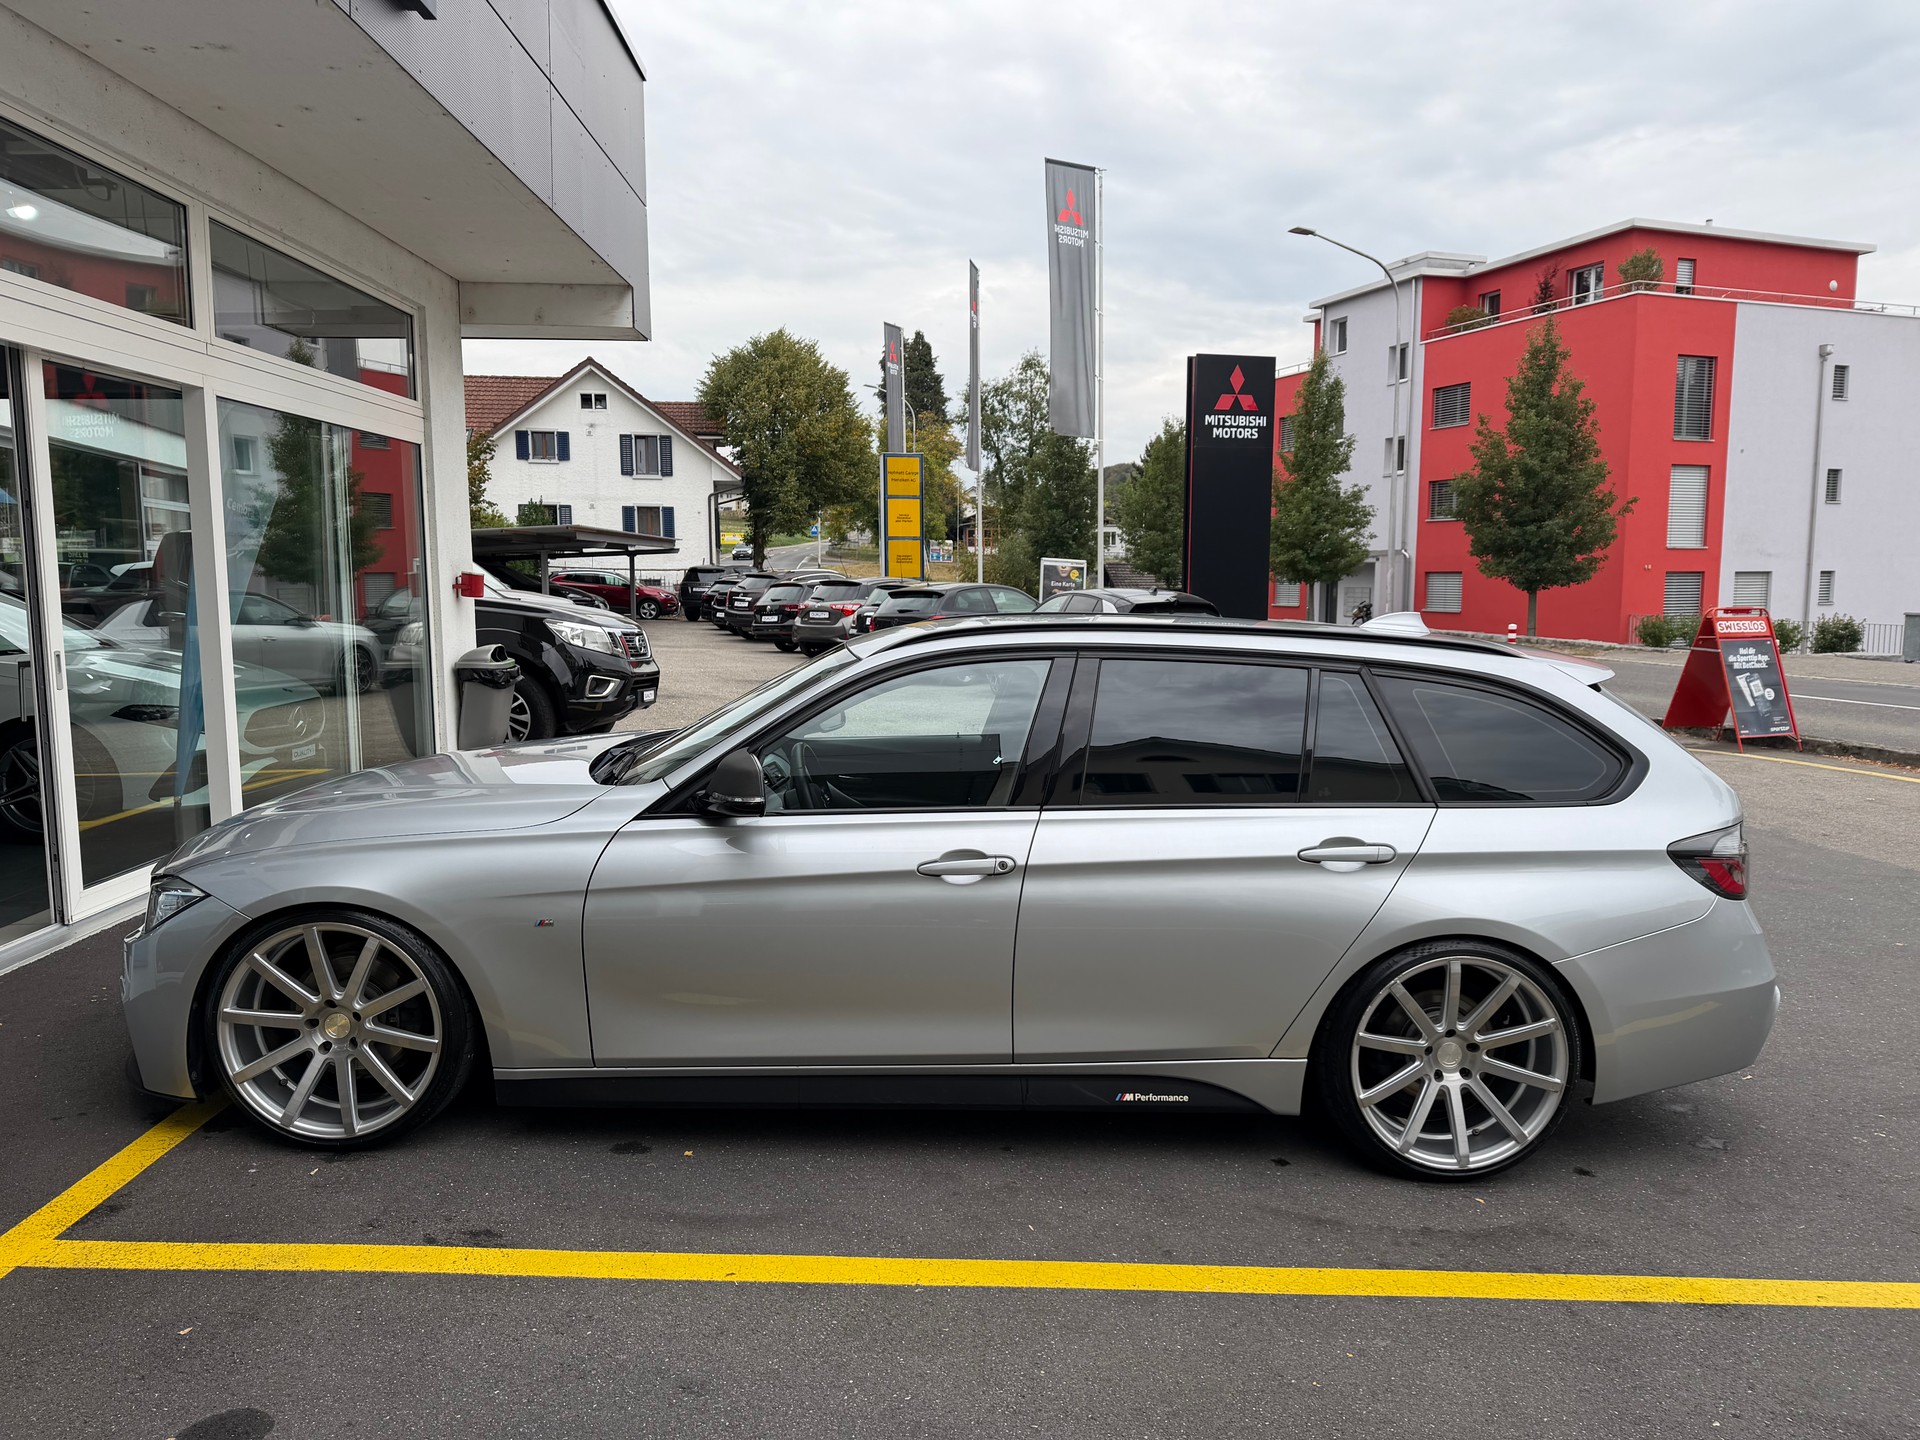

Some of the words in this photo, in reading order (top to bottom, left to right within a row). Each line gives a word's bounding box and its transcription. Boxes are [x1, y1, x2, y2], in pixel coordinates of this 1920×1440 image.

[1205, 414, 1267, 427] MITSUBISHI
[1212, 427, 1259, 439] MOTORS
[1718, 622, 1766, 631] SWISSLOS
[1135, 1093, 1189, 1102] Performance
